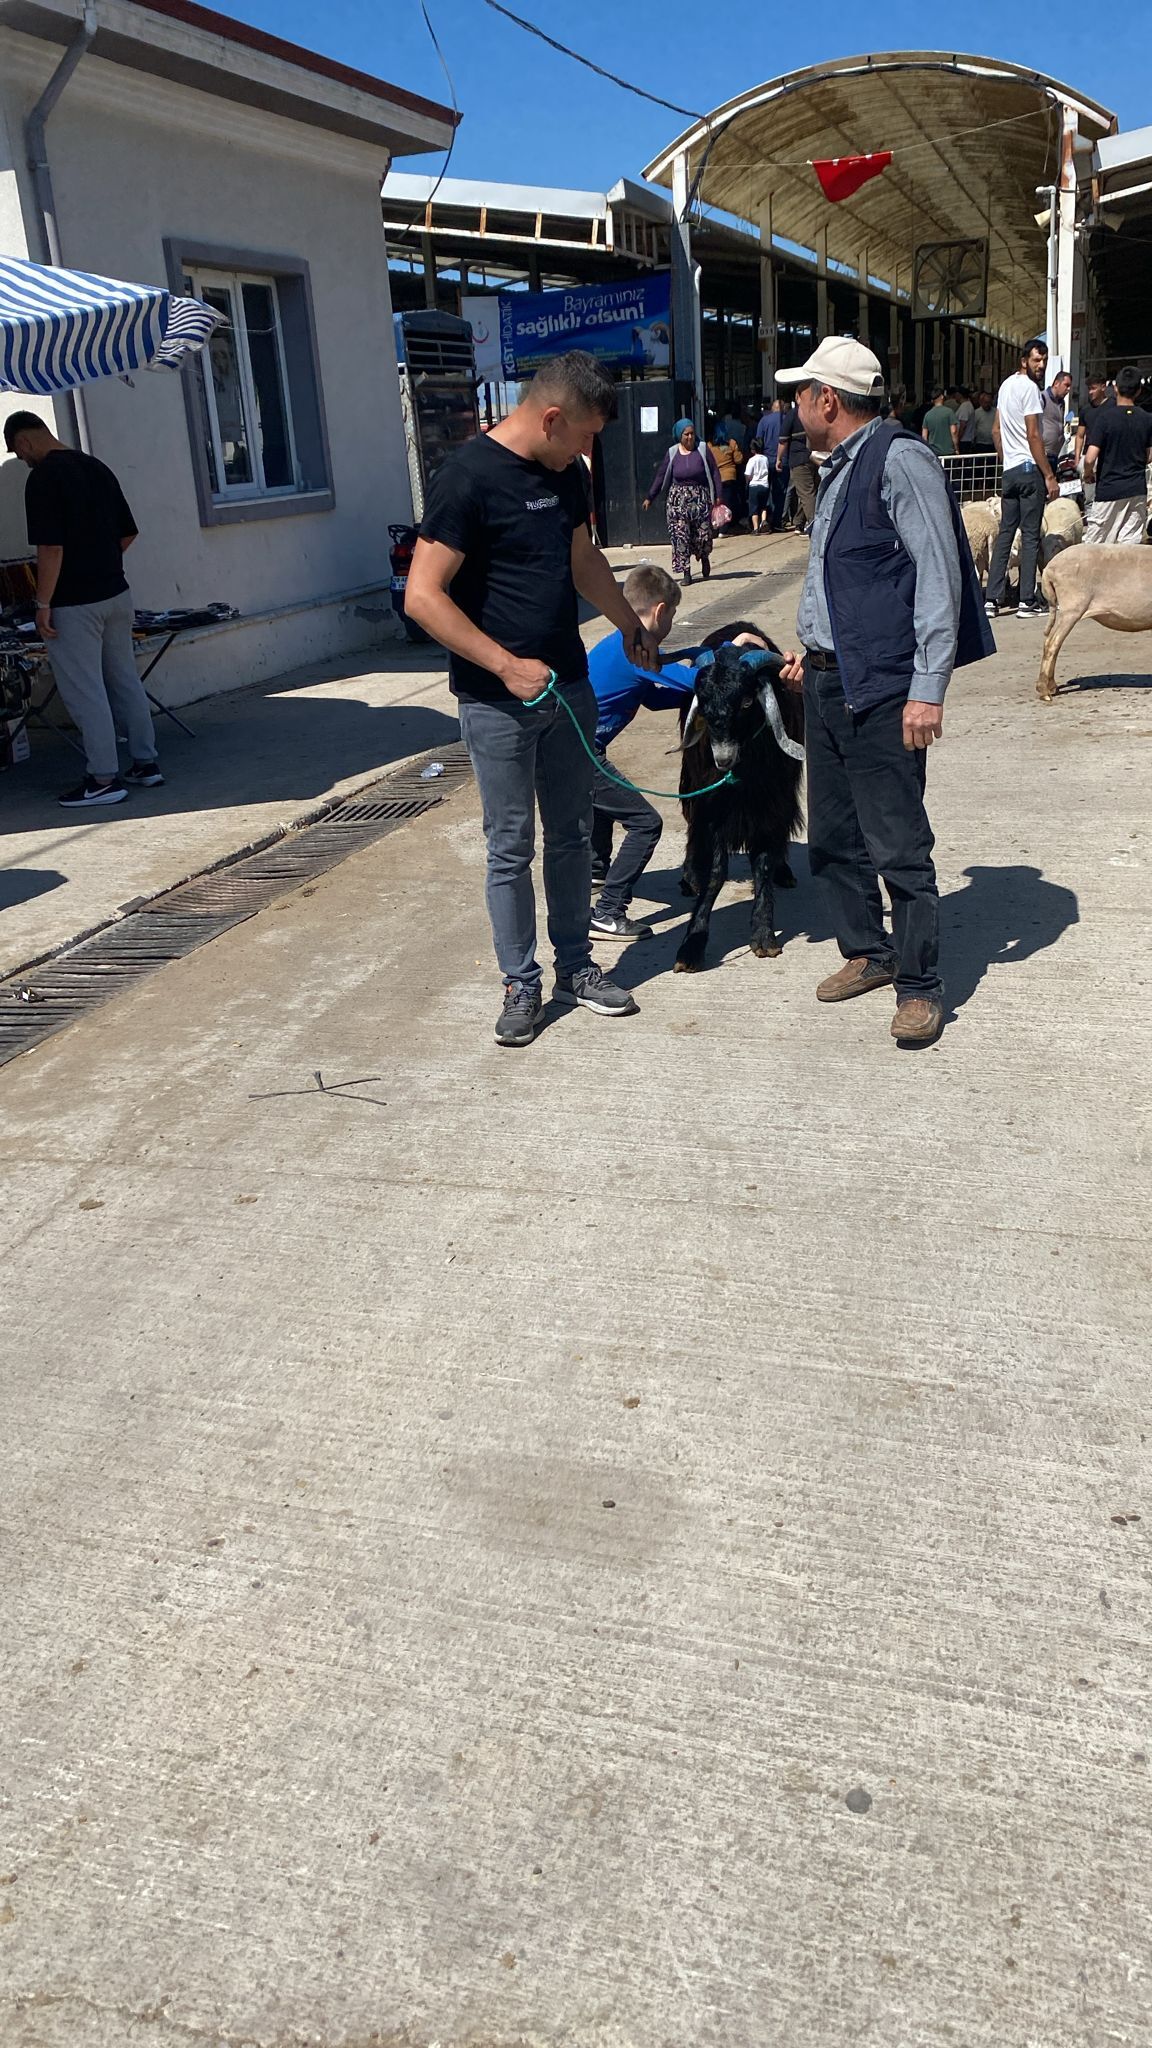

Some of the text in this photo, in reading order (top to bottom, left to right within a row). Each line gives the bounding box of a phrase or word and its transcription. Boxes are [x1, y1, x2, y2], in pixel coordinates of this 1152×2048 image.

[564, 288, 645, 314] Bayramınız
[516, 302, 645, 338] sağlıklı olsun!
